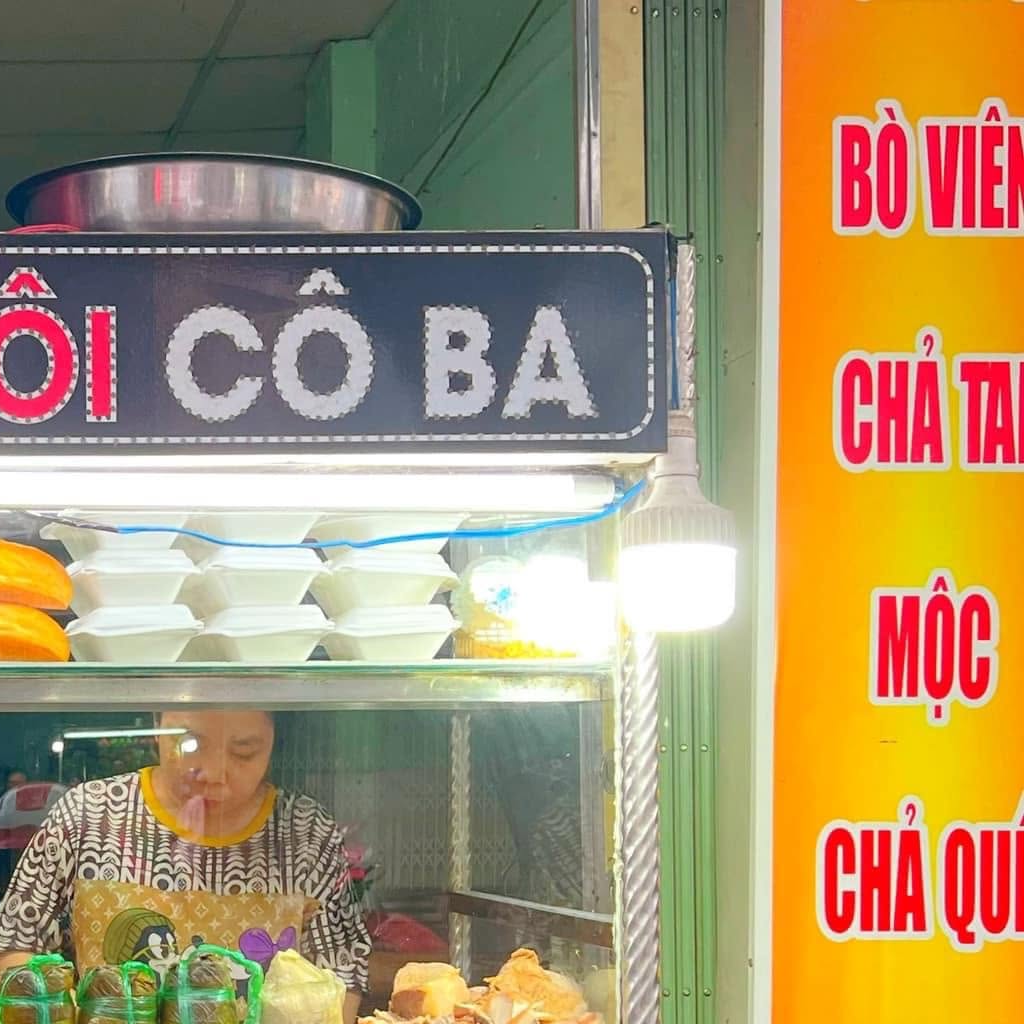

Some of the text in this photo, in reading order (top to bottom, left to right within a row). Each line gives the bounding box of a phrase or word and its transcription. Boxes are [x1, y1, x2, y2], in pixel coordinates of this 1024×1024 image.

[840, 106, 908, 230] BÒ
[163, 267, 600, 423] CÔ BA
[840, 333, 1024, 464] CHẢ TA
[876, 575, 991, 719] MỘC
[823, 802, 927, 934] CHẢ
